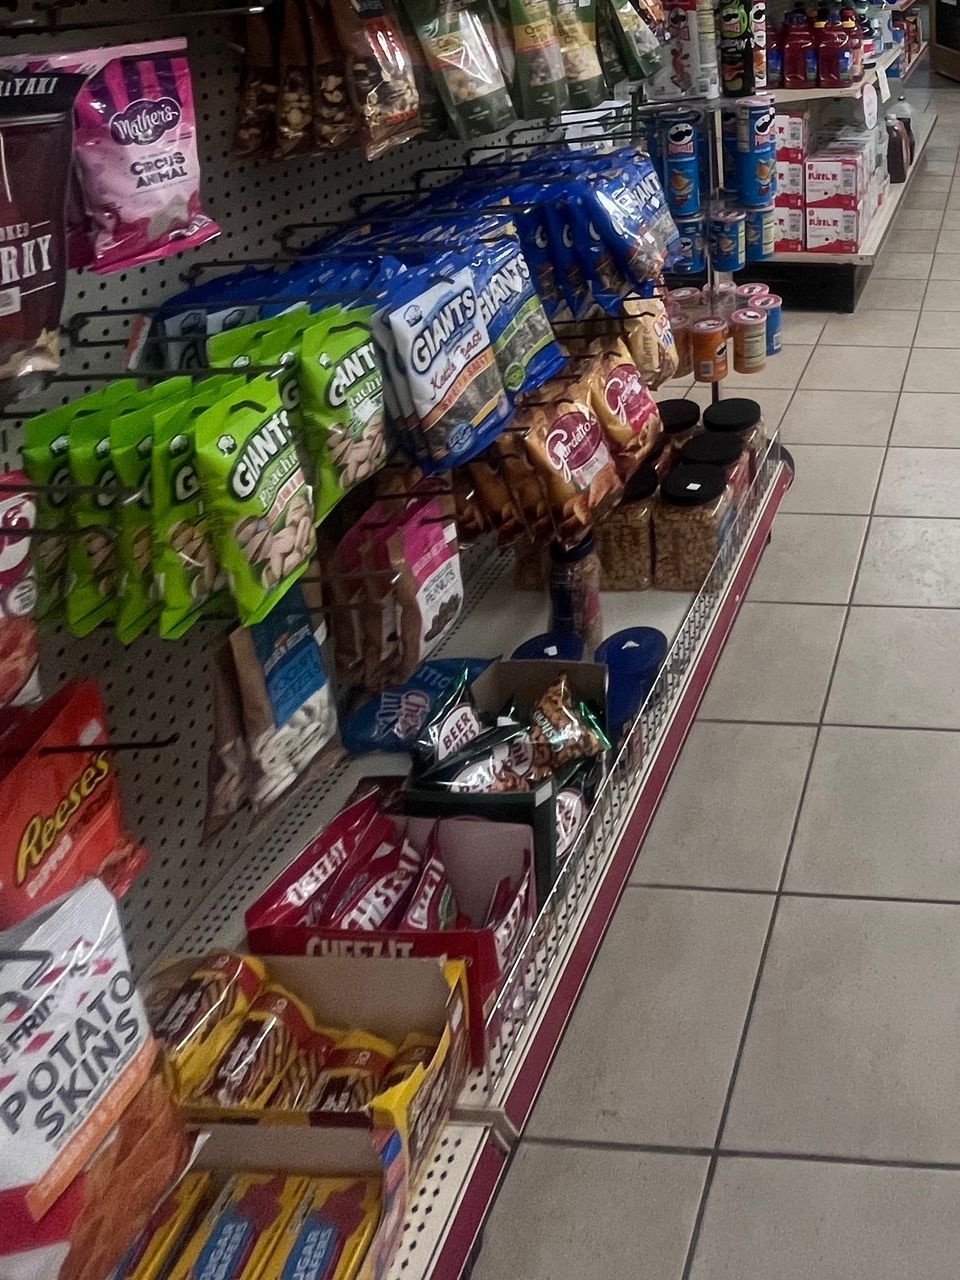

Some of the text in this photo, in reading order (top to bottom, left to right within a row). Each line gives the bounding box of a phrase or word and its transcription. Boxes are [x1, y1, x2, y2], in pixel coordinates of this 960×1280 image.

[130, 151, 186, 175] CIRCUS
[136, 166, 188, 189] ANIMAL
[412, 288, 476, 374] GIANTS
[442, 712, 472, 751] BEER
[0, 971, 135, 1134] POTATO
[35, 1008, 139, 1142] SKINS
